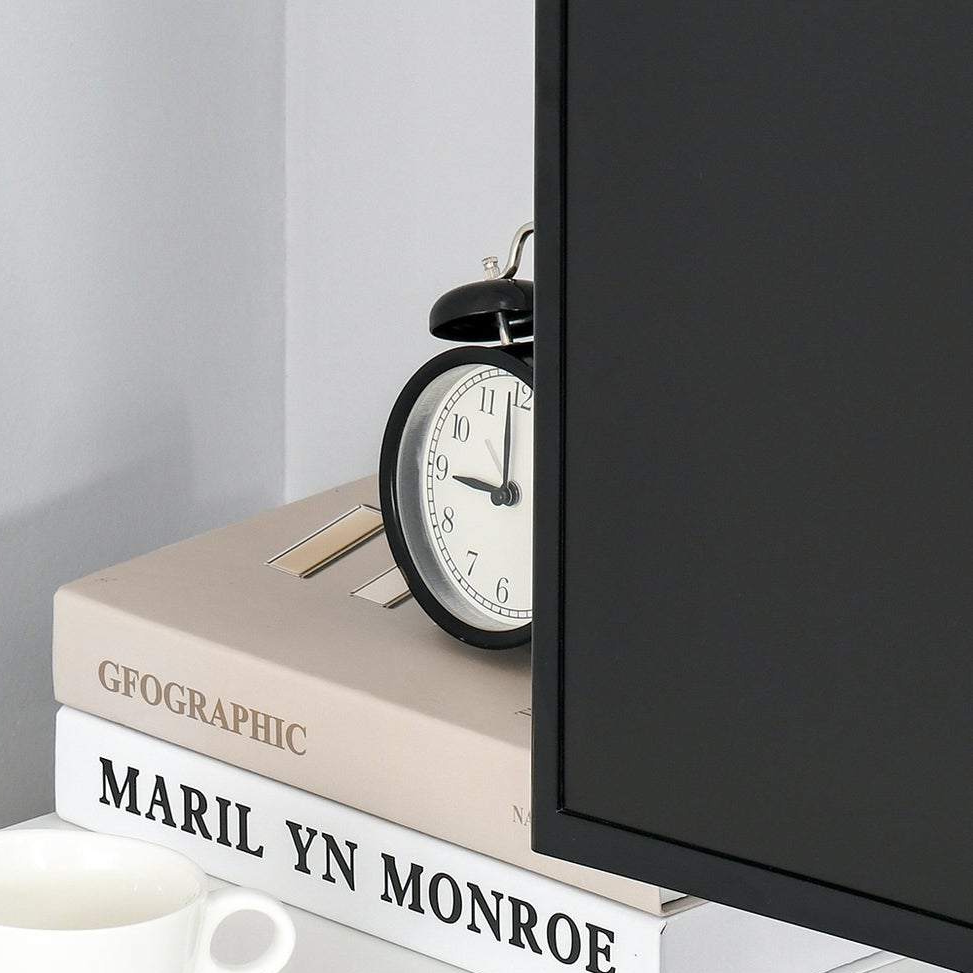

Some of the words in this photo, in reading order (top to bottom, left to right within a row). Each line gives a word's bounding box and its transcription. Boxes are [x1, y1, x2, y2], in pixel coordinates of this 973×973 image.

[479, 385, 495, 416] 11
[513, 380, 532, 411] 12
[451, 413, 471, 443] 10
[435, 453, 449, 482] 9
[441, 505, 455, 534] 8
[465, 549, 479, 577] 7
[495, 576, 510, 604] 6
[98, 659, 307, 756] GFOGRAPHIC
[99, 757, 265, 859] MARIL
[285, 819, 359, 893] YN
